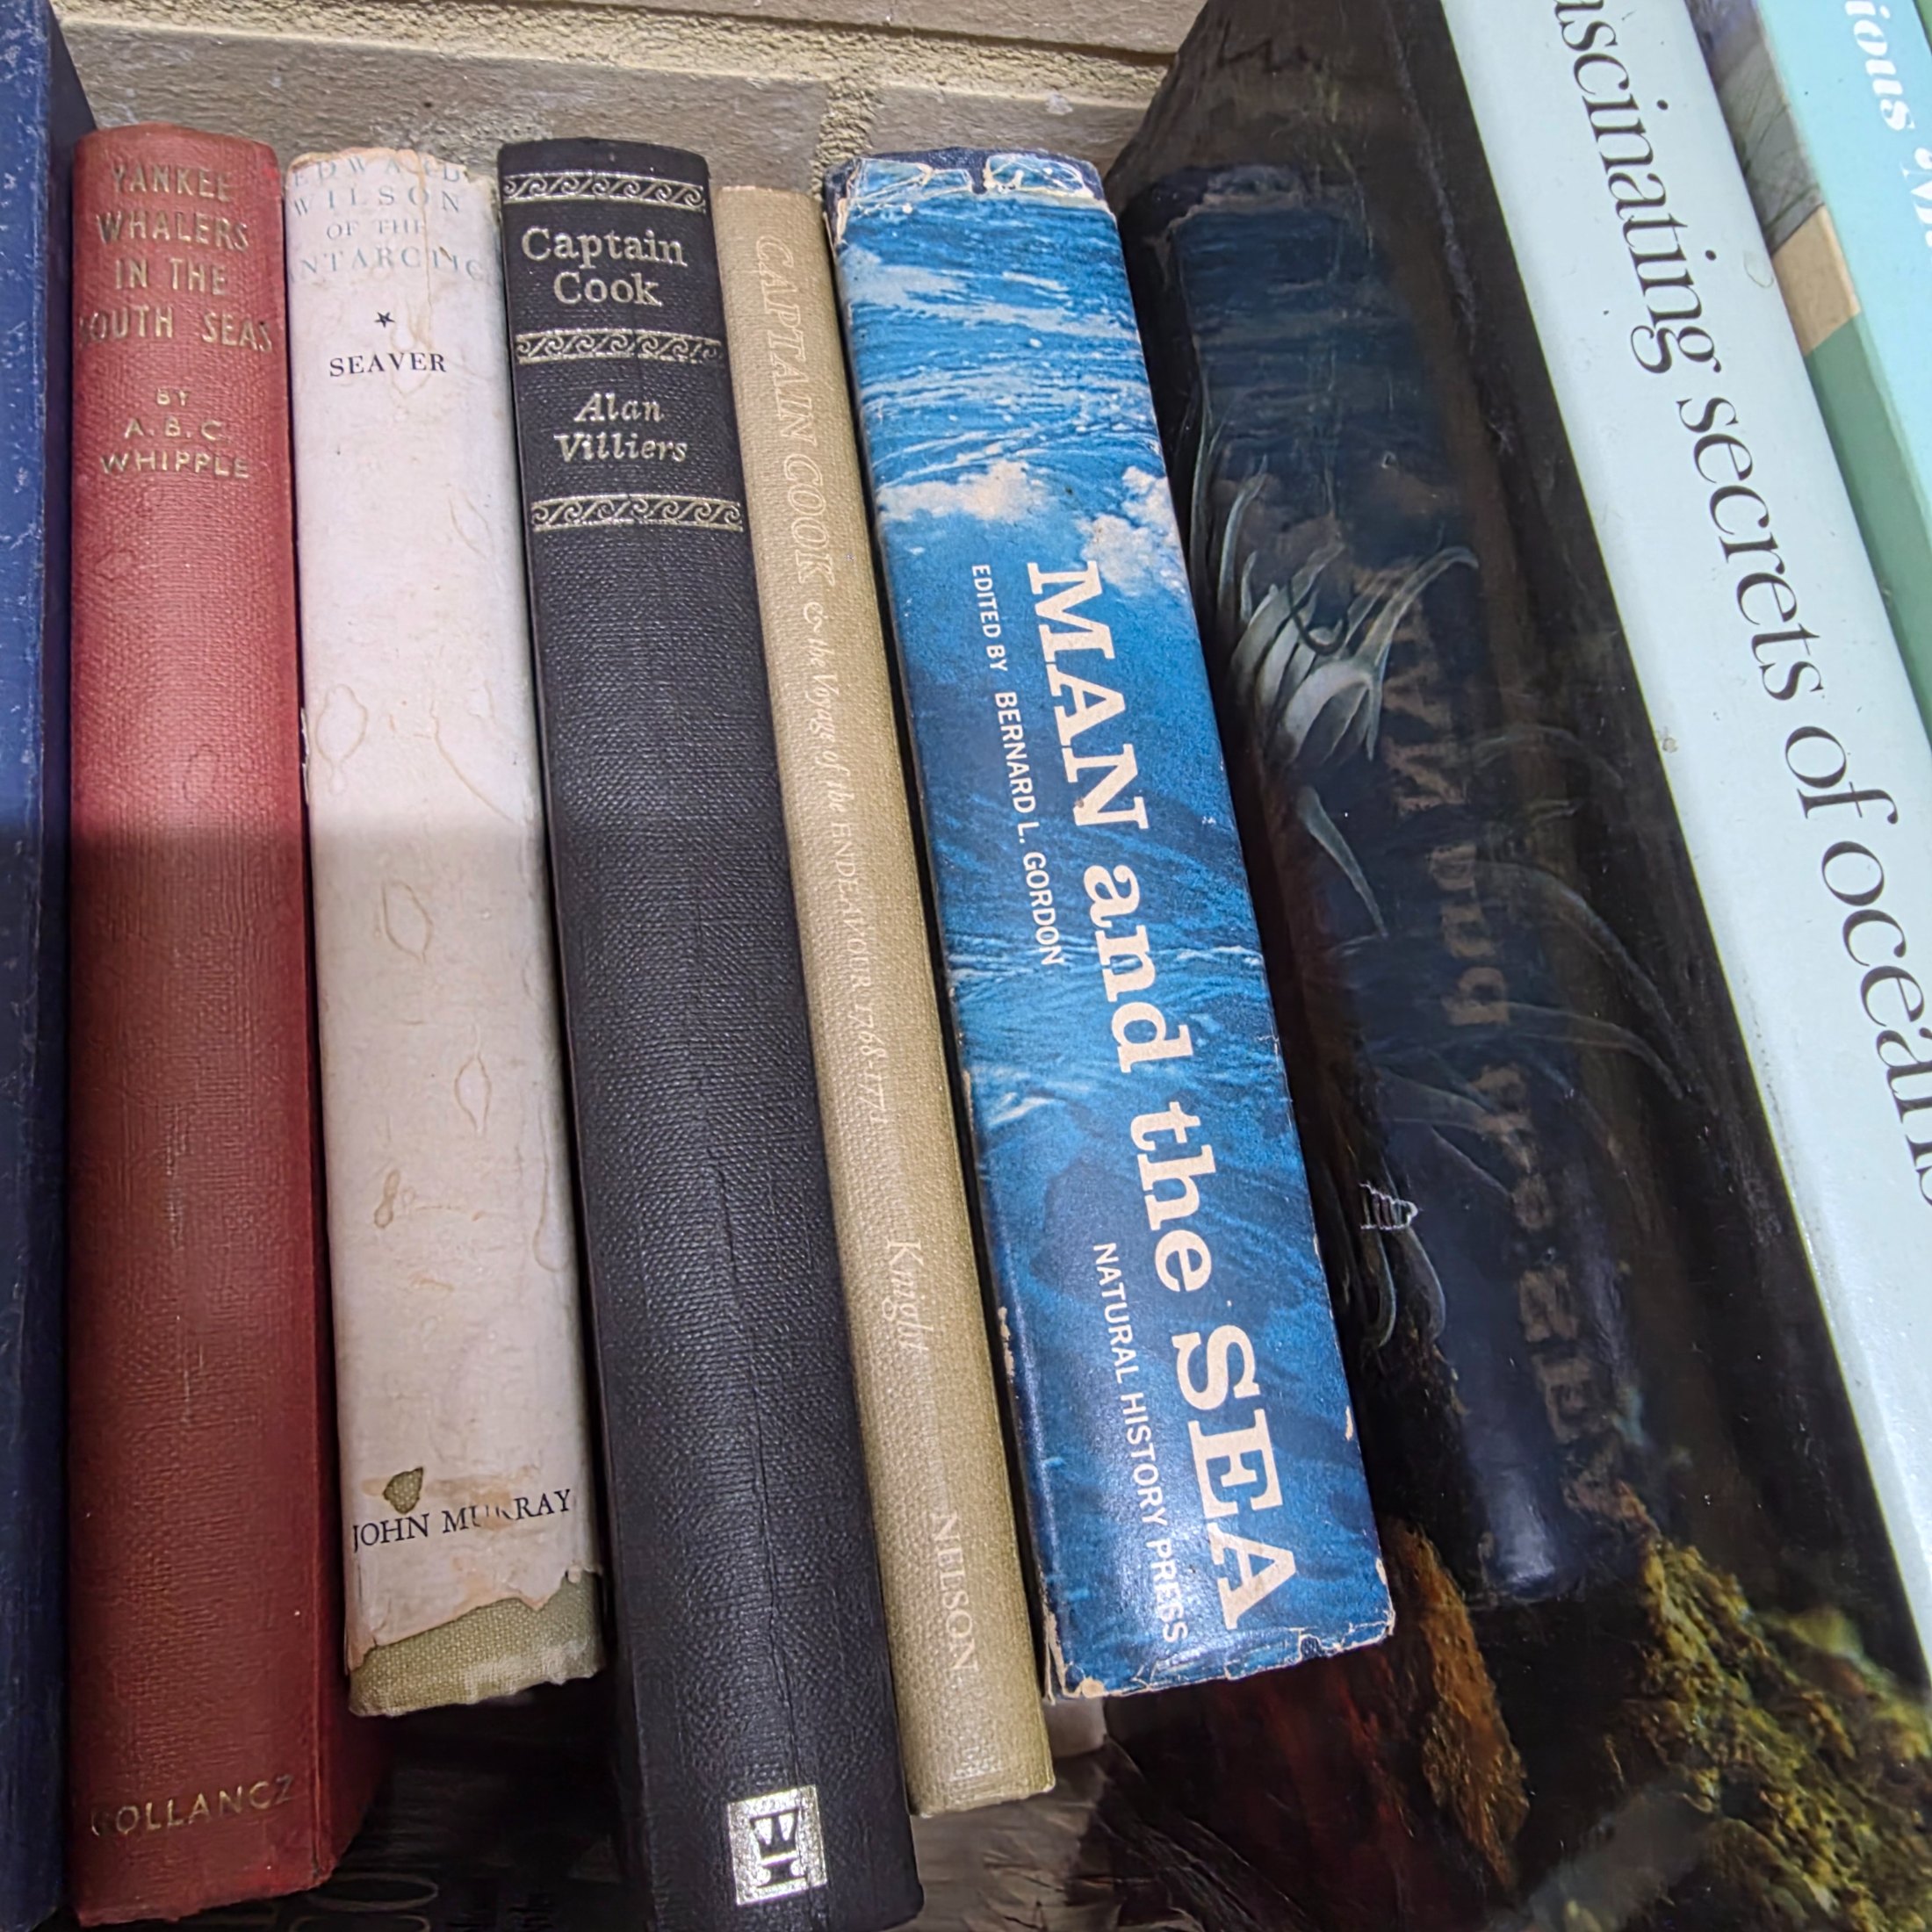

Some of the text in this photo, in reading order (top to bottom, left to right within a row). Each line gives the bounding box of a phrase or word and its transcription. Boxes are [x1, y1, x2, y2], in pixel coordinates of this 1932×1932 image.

[112, 162, 232, 202] YANKEE
[293, 184, 460, 217] WILSON
[96, 211, 249, 253] WHALERS
[326, 219, 427, 241] OF THE
[521, 226, 688, 270] Captain
[115, 257, 227, 296] IN THE
[553, 271, 663, 307] Cook
[201, 310, 272, 353] SEAS
[755, 234, 818, 446] CAPTAIN
[329, 352, 447, 378] SEAVER
[156, 388, 191, 407] BY
[573, 393, 665, 422] Alan
[100, 451, 250, 479] WHIPPLE
[553, 431, 688, 463] Villiers
[783, 453, 835, 587] COOK
[1676, 395, 1823, 701] secrets
[1784, 725, 1899, 825] of
[815, 751, 851, 777] of
[971, 565, 1065, 967] EDITED BY BERNARD L. GORDON
[1027, 560, 1298, 1631] MAN and the SEA
[882, 1238, 934, 1355] Knight
[1093, 1242, 1189, 1643] NATURAL HISTORY PRESS
[353, 1512, 430, 1553] JOHN
[932, 1511, 979, 1673] NELSON
